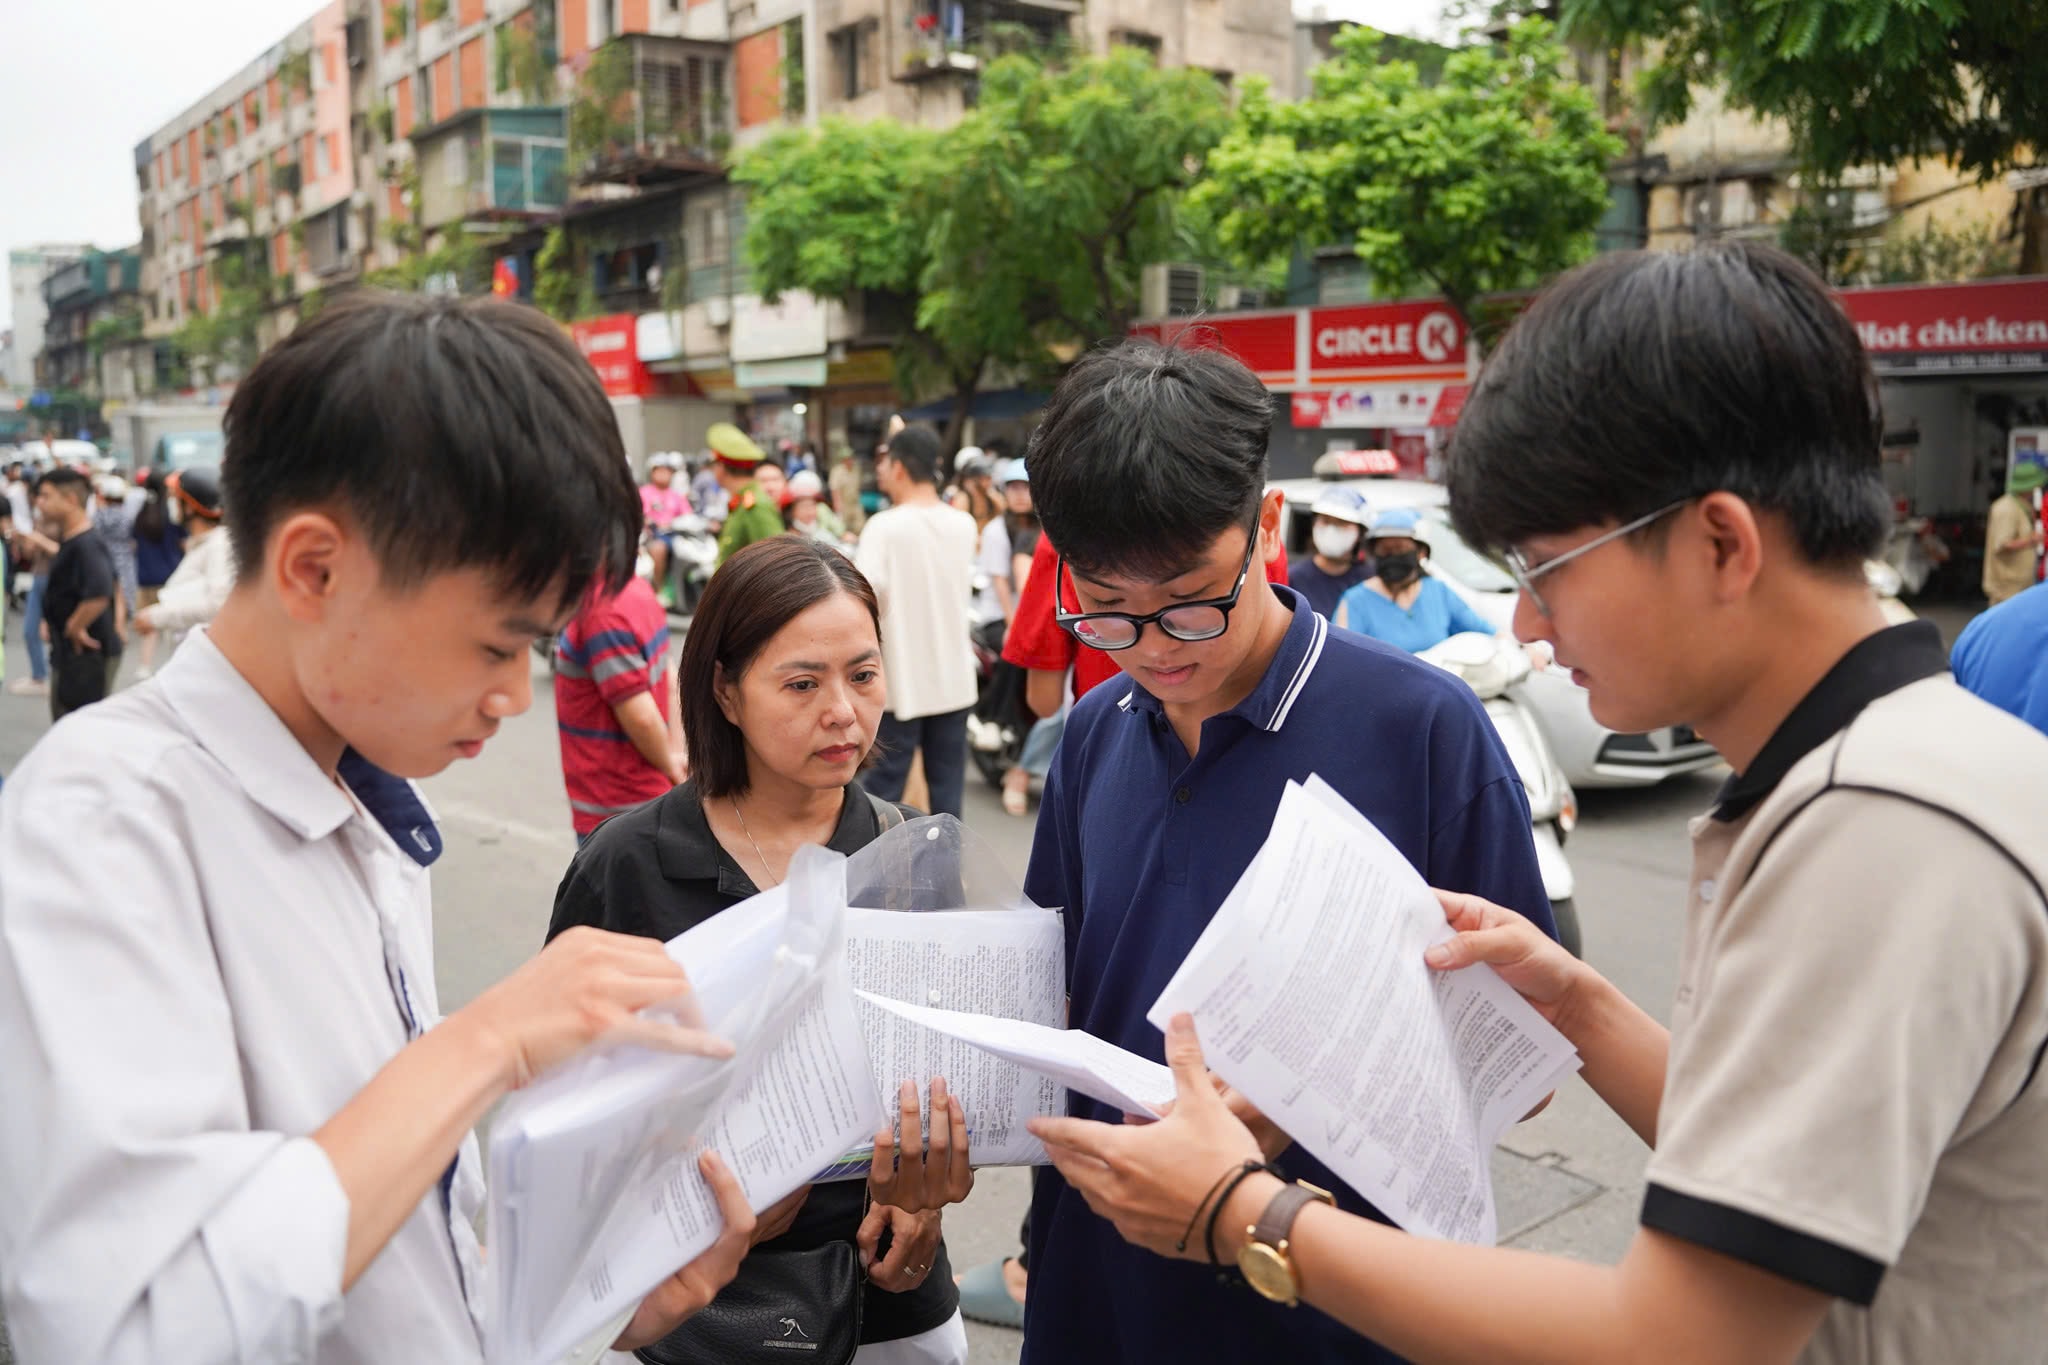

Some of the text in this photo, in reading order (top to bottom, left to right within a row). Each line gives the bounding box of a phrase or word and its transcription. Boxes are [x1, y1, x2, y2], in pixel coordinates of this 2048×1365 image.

[1317, 312, 1457, 361] CIRCLE K
[1917, 315, 2048, 347] chicken
